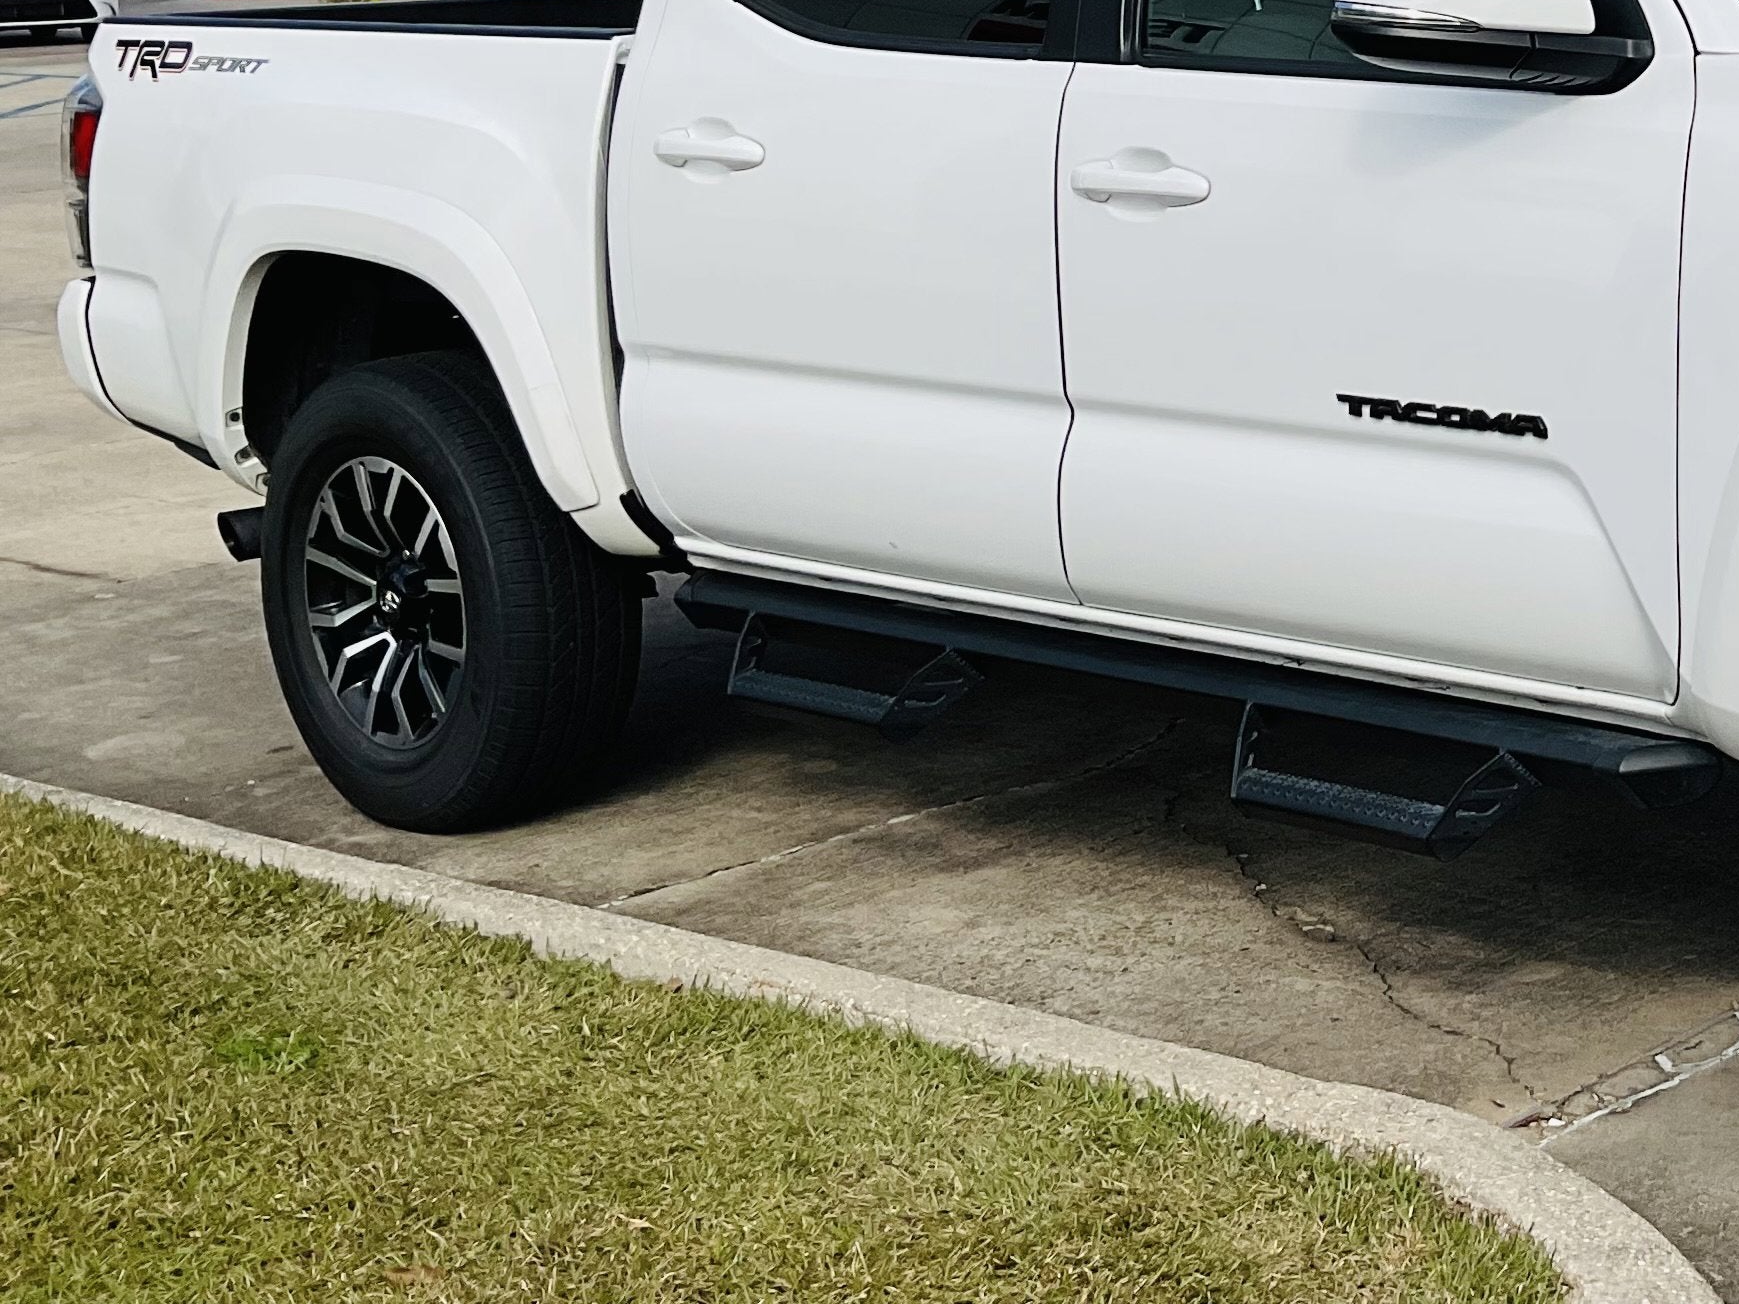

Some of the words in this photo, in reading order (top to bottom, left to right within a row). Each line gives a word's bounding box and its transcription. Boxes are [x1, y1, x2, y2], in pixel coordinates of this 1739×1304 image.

[116, 40, 194, 82] TRD
[189, 56, 269, 74] SPORT
[1335, 393, 1549, 439] TACOMA
